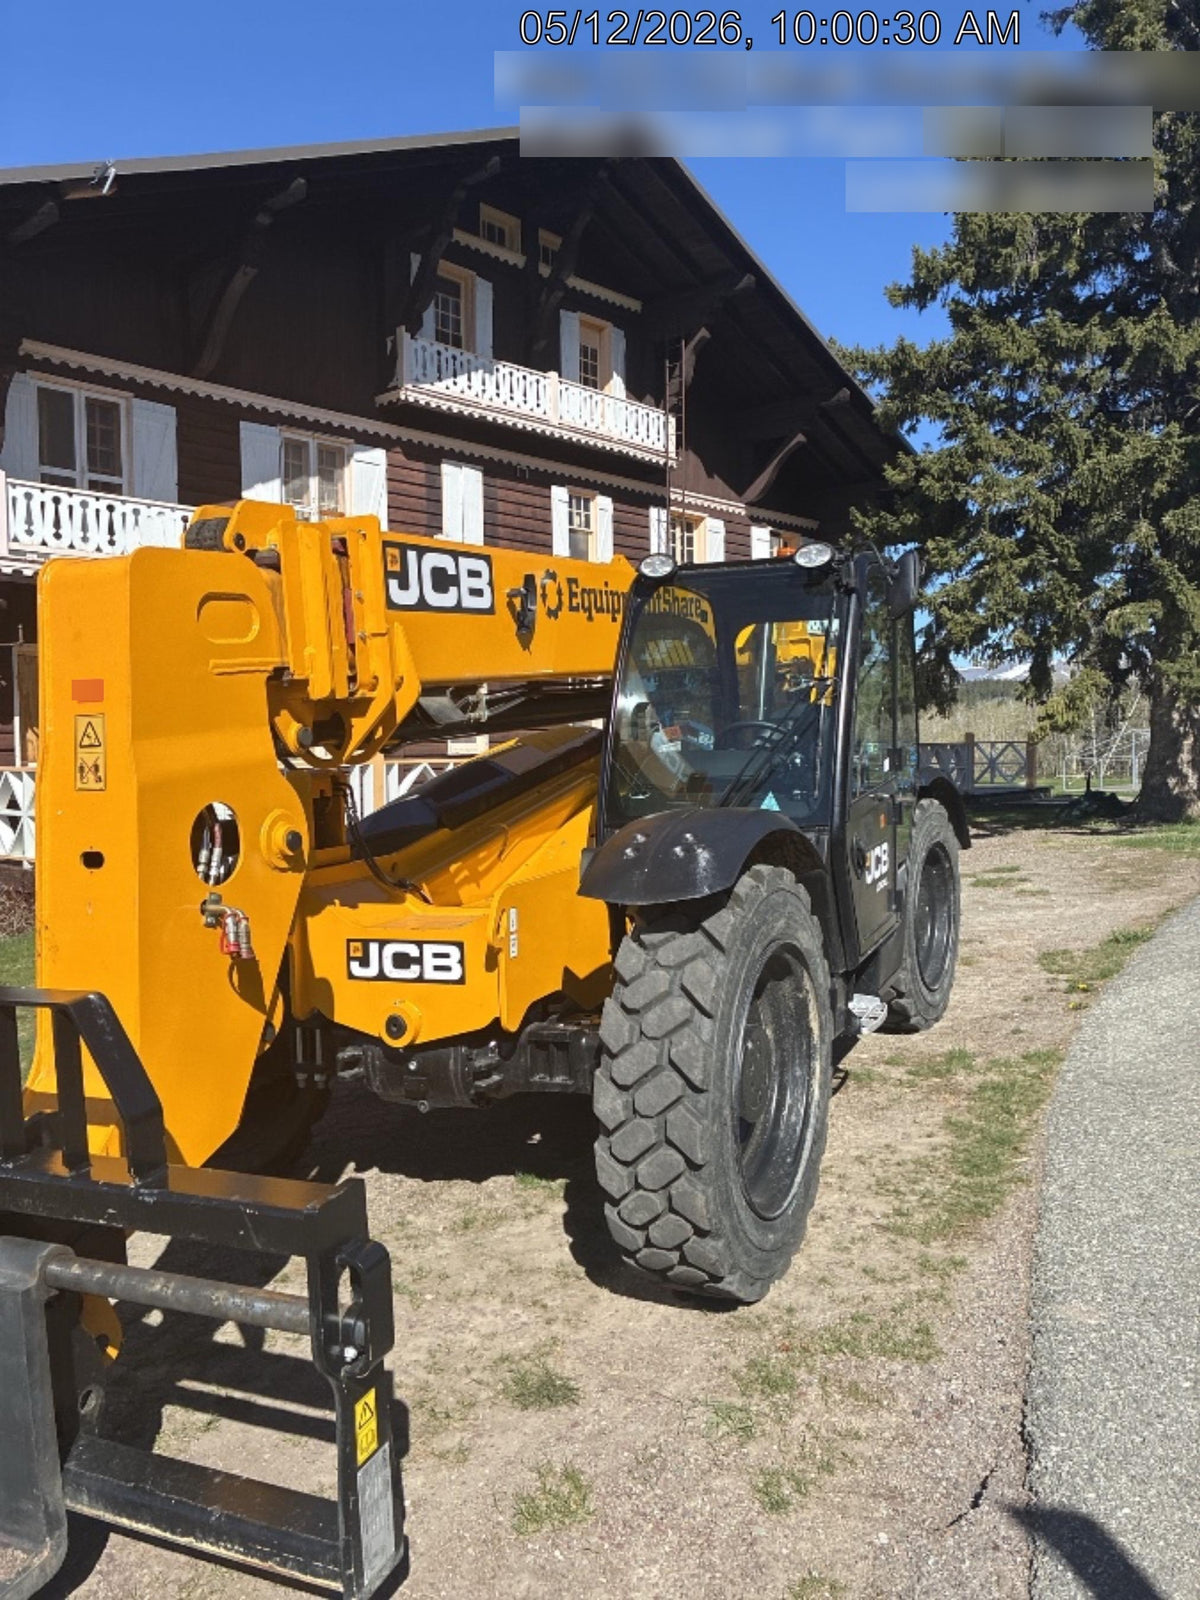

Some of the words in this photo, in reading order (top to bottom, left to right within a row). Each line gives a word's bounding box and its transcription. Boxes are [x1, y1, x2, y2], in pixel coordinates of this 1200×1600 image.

[387, 549, 493, 609] JCB
[566, 577, 702, 622] EquipntShare
[865, 842, 889, 885] JCB
[350, 942, 463, 981] JCB
